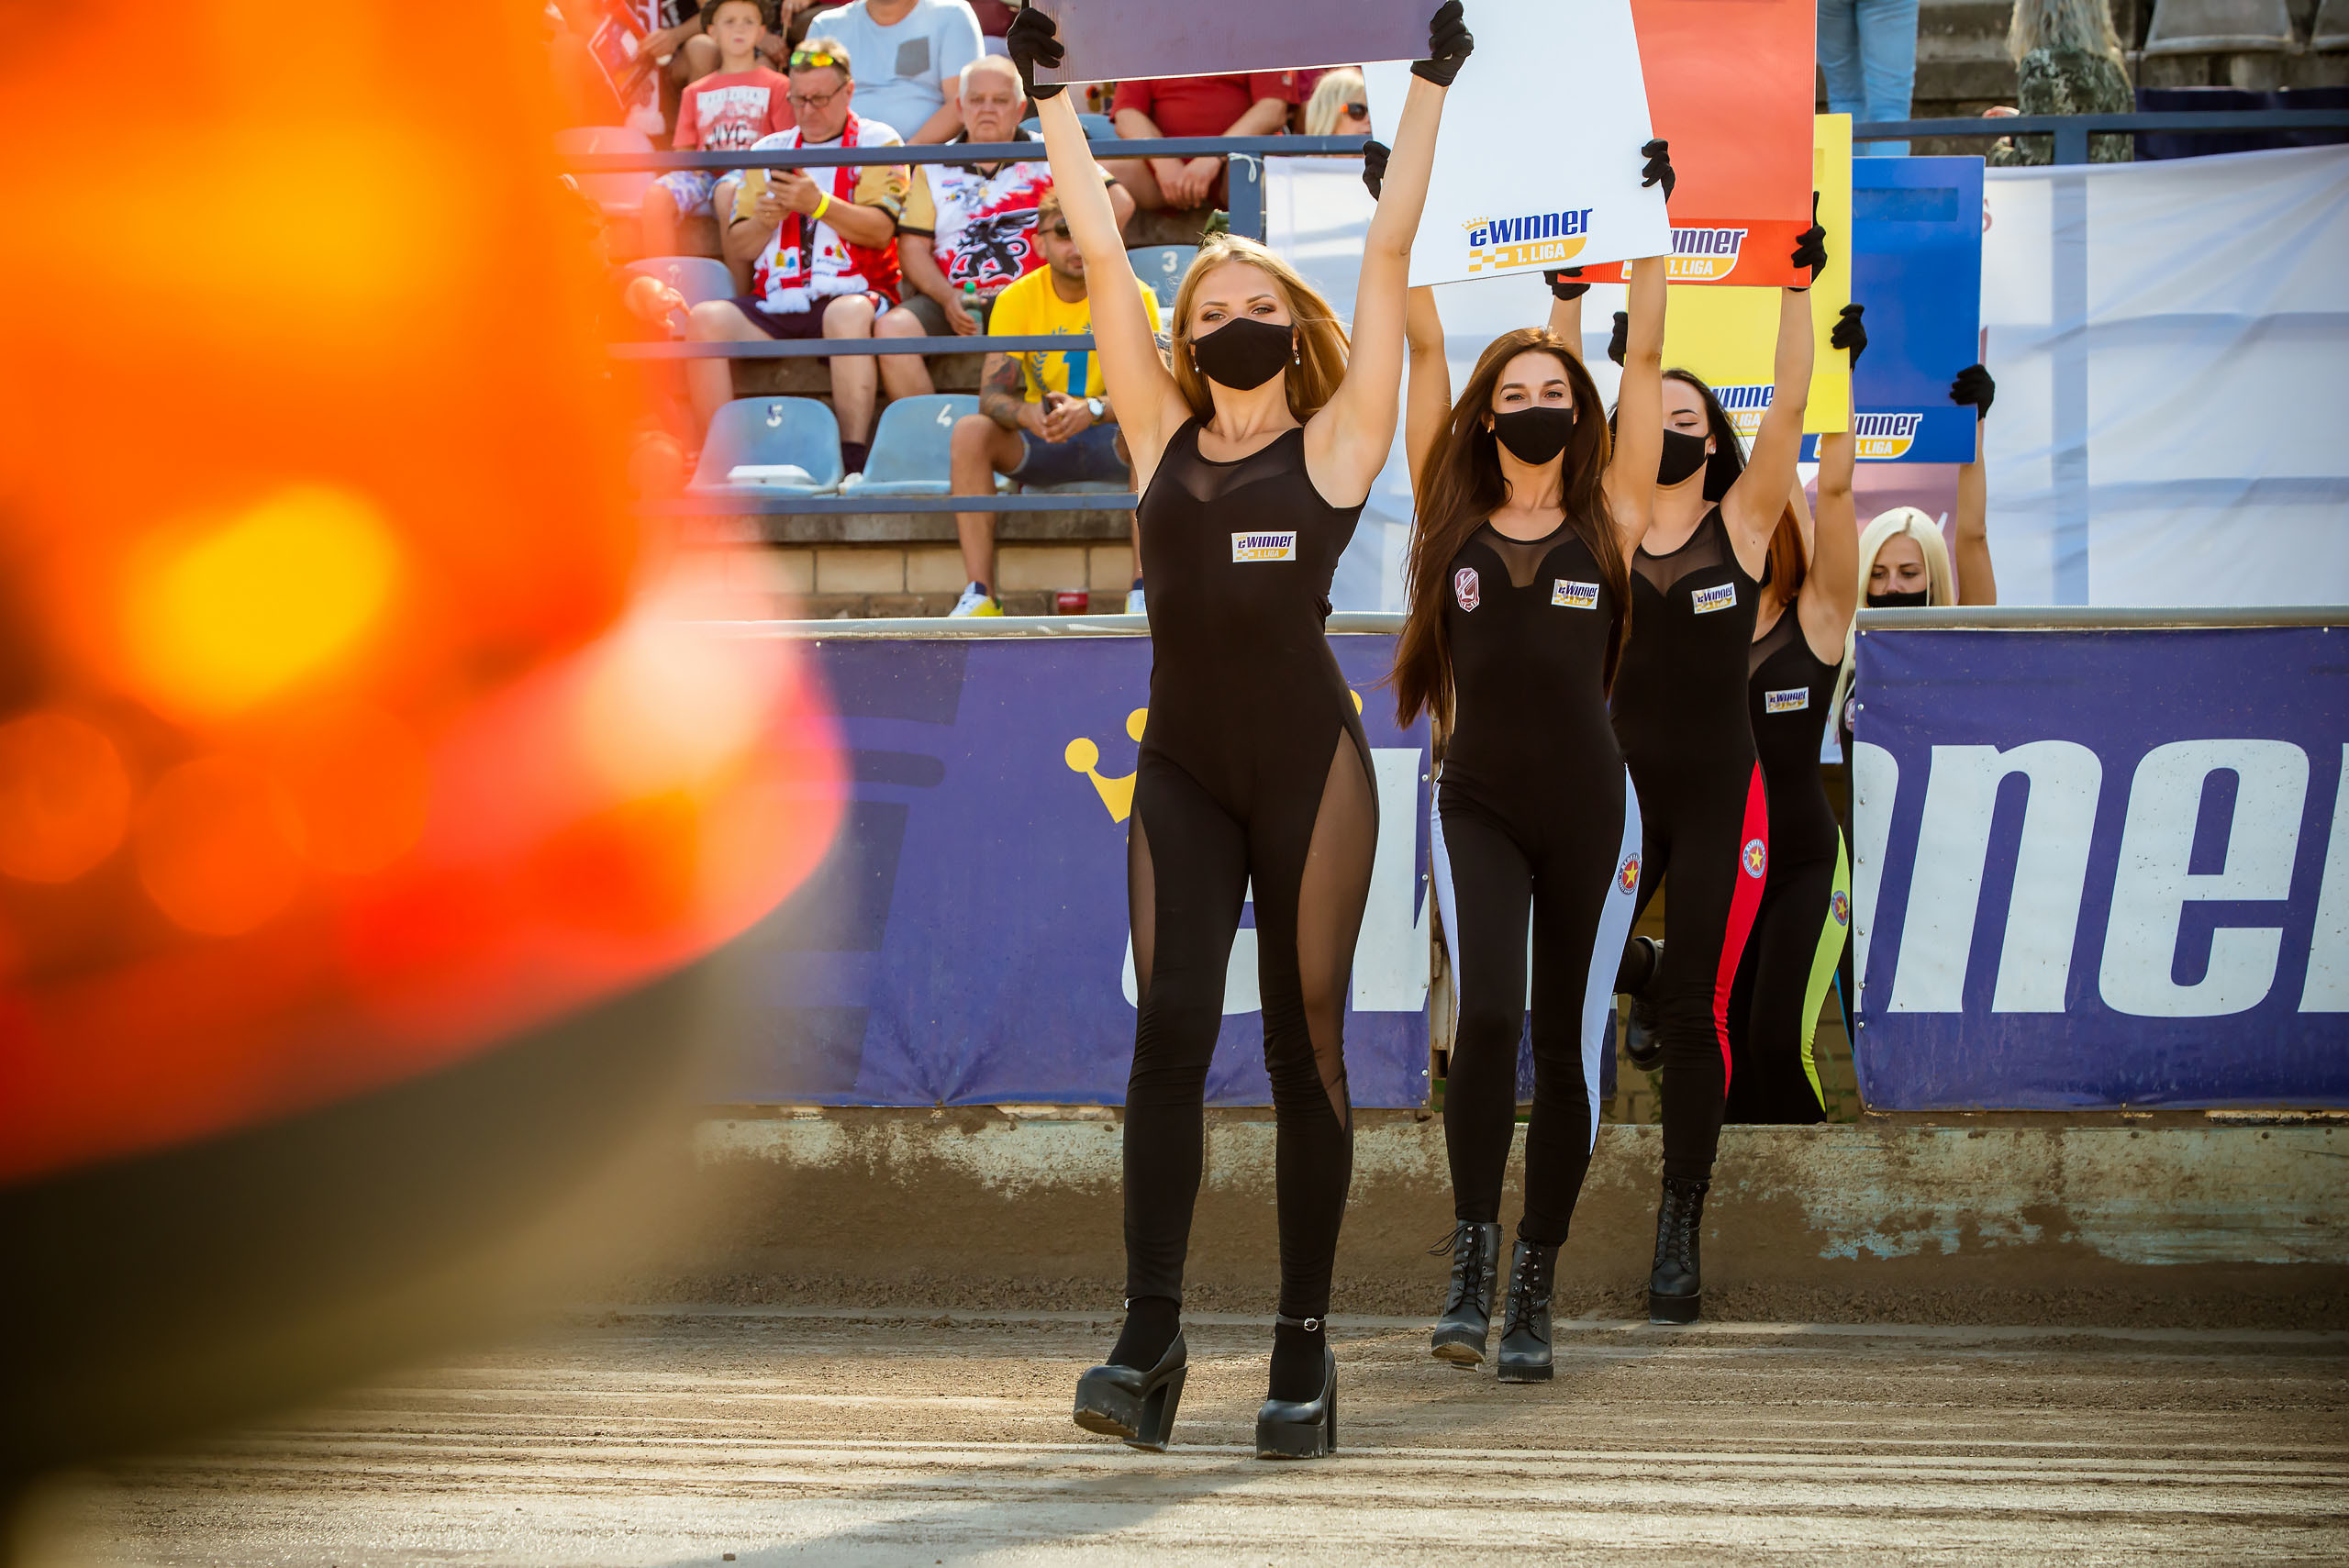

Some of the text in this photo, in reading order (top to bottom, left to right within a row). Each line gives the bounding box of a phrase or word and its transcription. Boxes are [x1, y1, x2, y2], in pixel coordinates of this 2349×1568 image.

[1671, 229, 1745, 254] inner
[1162, 250, 1178, 272] 3
[1516, 243, 1565, 263] 1. LIGA
[1669, 260, 1714, 275] 1. LIGA
[936, 404, 952, 428] 4
[1855, 416, 1920, 436] inner
[1865, 440, 1893, 454] LIGA
